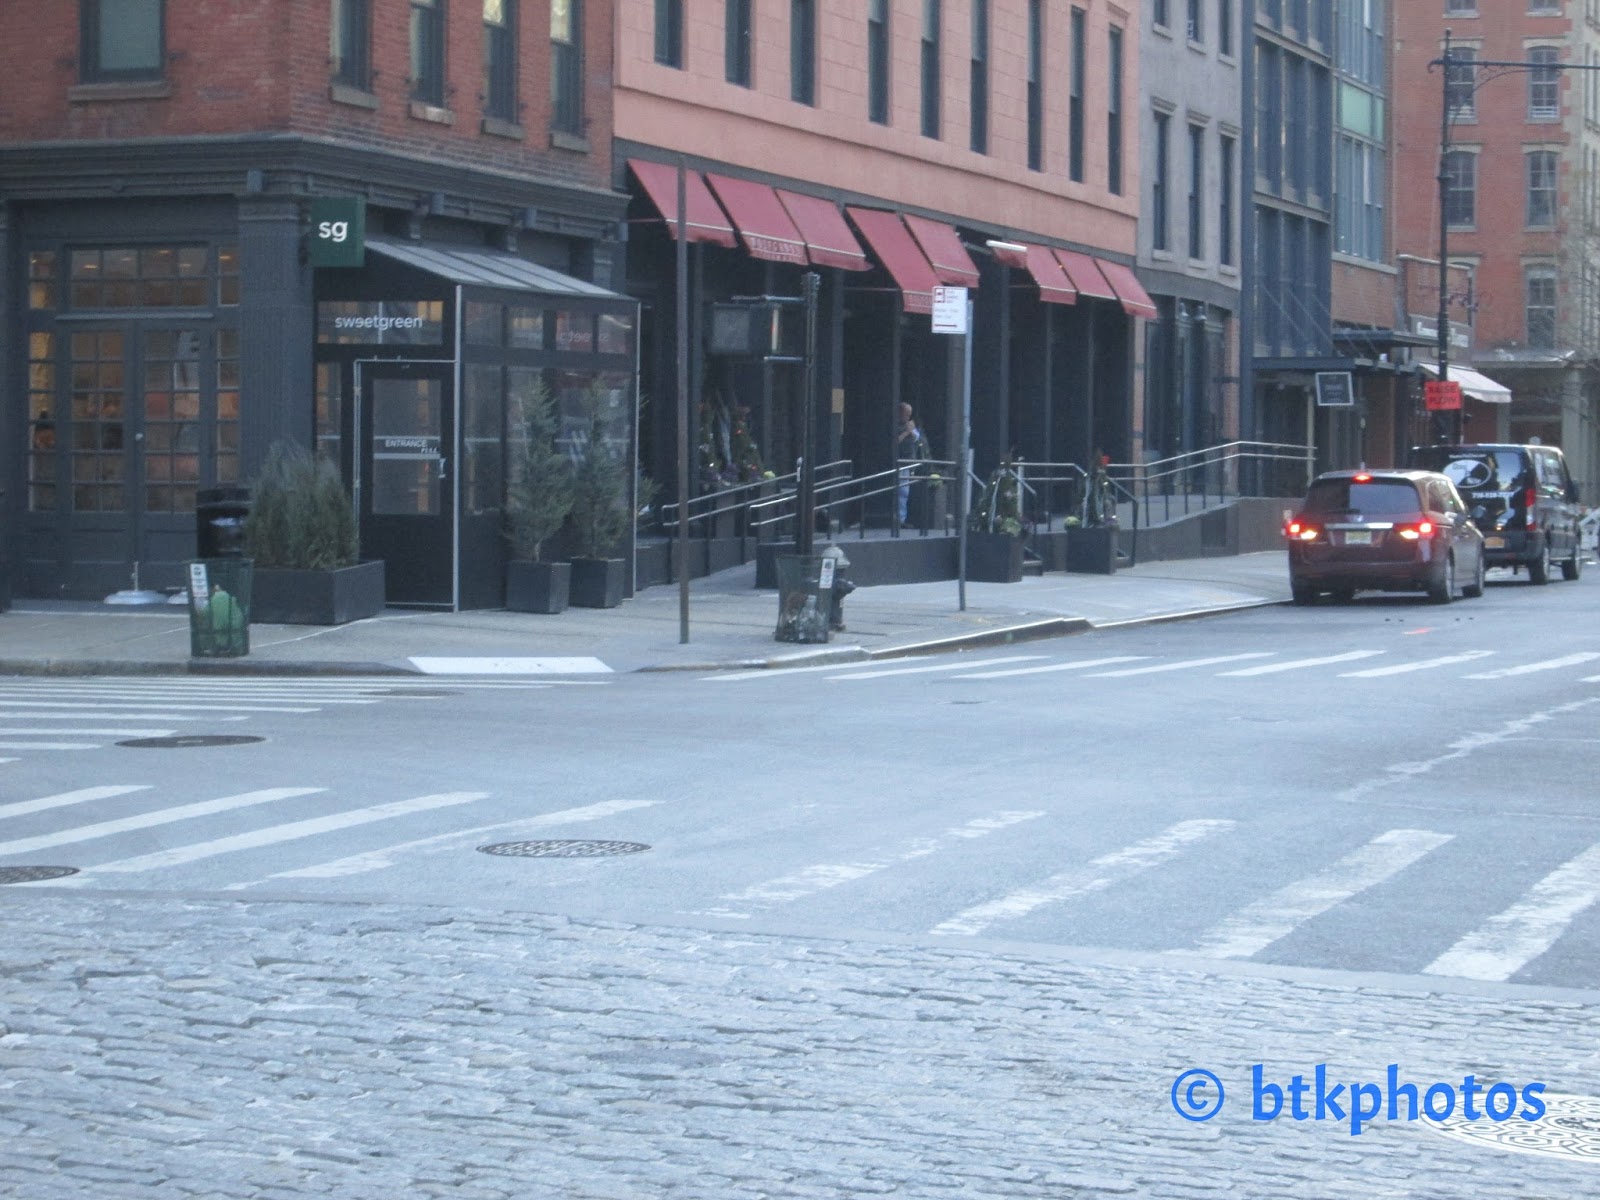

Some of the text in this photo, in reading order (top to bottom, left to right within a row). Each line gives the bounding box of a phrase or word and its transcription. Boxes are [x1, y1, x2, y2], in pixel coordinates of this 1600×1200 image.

[318, 221, 348, 242] sg
[335, 315, 422, 330] sweetgreen
[385, 440, 427, 448] ENTRANCE
